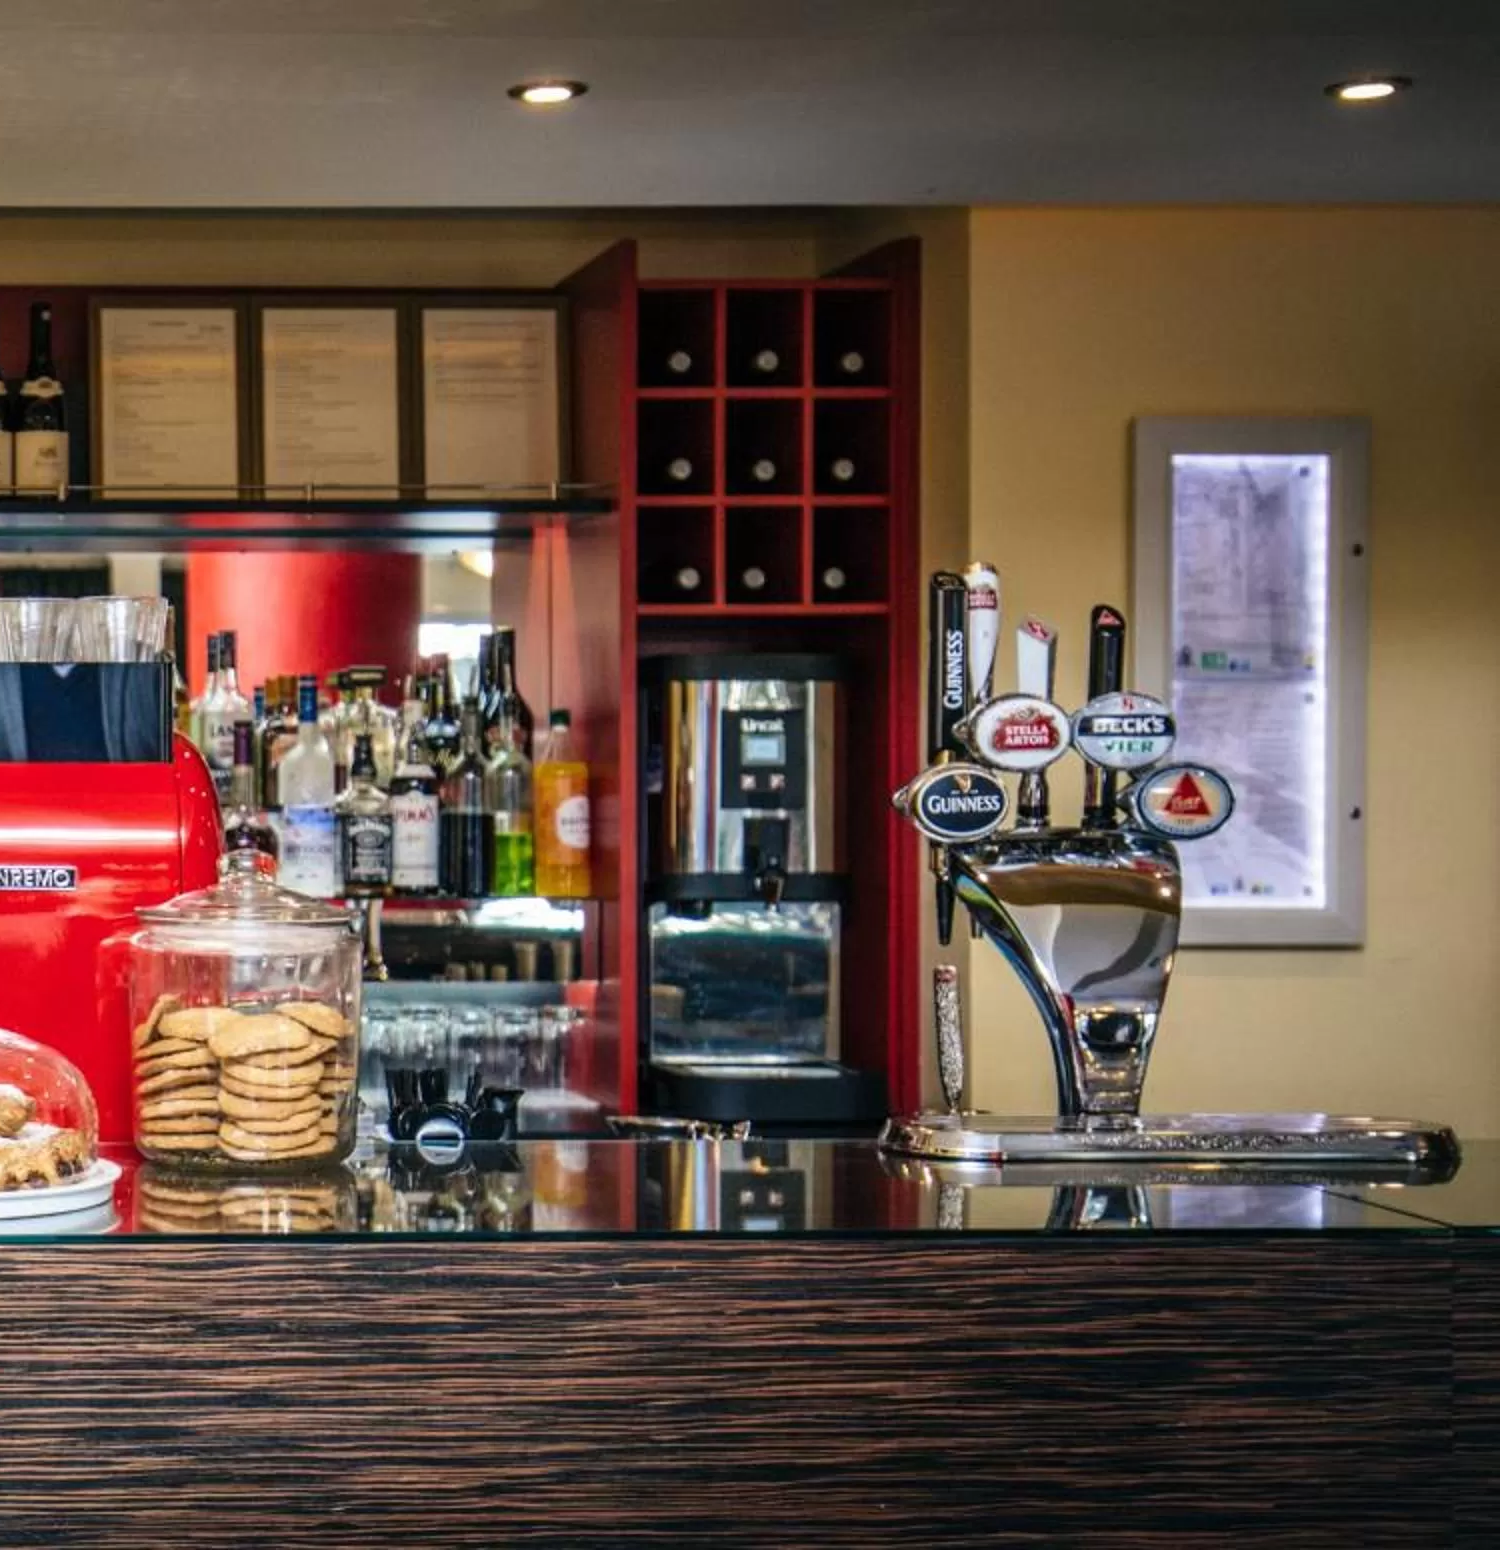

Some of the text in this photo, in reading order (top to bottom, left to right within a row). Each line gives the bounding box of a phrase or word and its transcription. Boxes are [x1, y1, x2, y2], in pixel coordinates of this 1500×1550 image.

[943, 628, 964, 710] GUINNESS
[1005, 724, 1049, 735] STELLA
[1092, 714, 1165, 734] BECK'S
[1106, 740, 1154, 752] VIER
[927, 794, 1001, 814] GUINNESS
